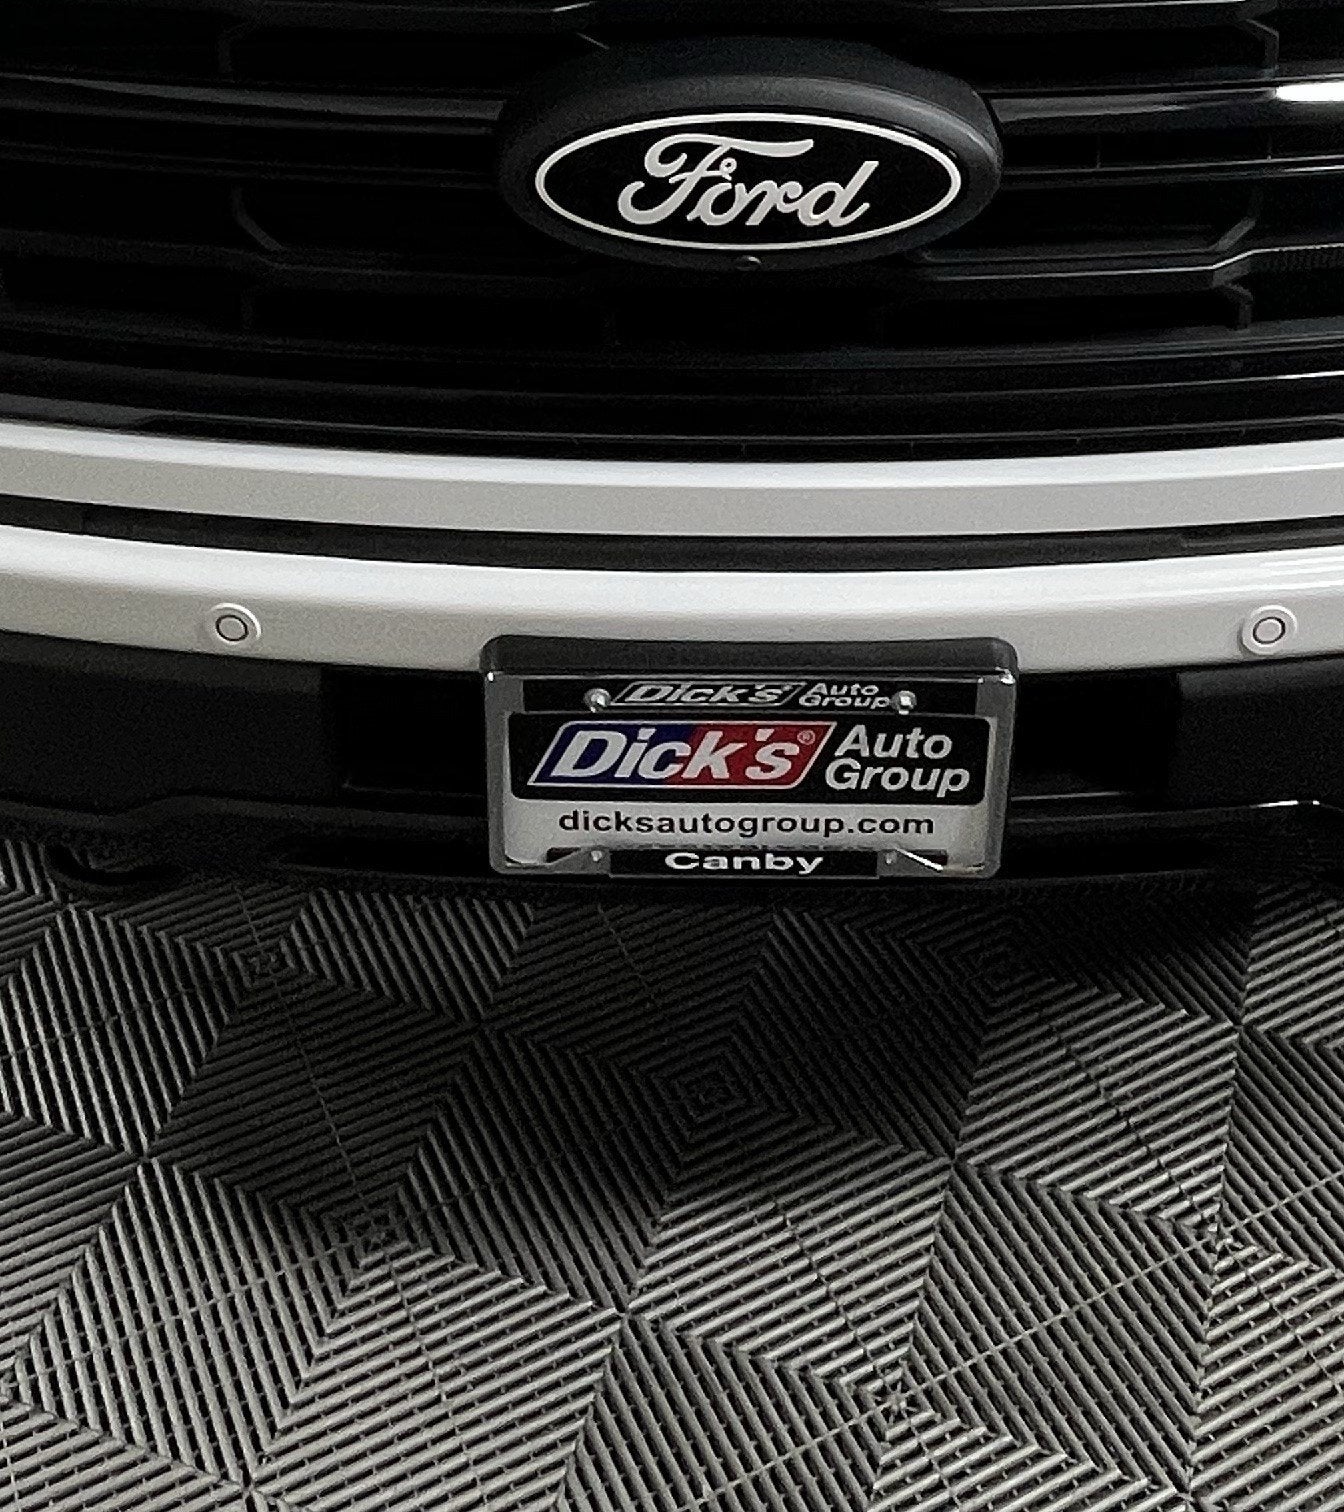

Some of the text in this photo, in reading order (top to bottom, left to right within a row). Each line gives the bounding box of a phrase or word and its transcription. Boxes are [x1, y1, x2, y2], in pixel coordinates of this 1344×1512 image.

[617, 133, 880, 228] Ford
[624, 682, 785, 703] Dick's
[798, 694, 892, 710] Group
[809, 683, 880, 696] Auto
[832, 724, 953, 760] Auto
[824, 758, 971, 797] Group
[558, 809, 936, 838] dicksautogroup.com
[664, 851, 825, 875] Canby
